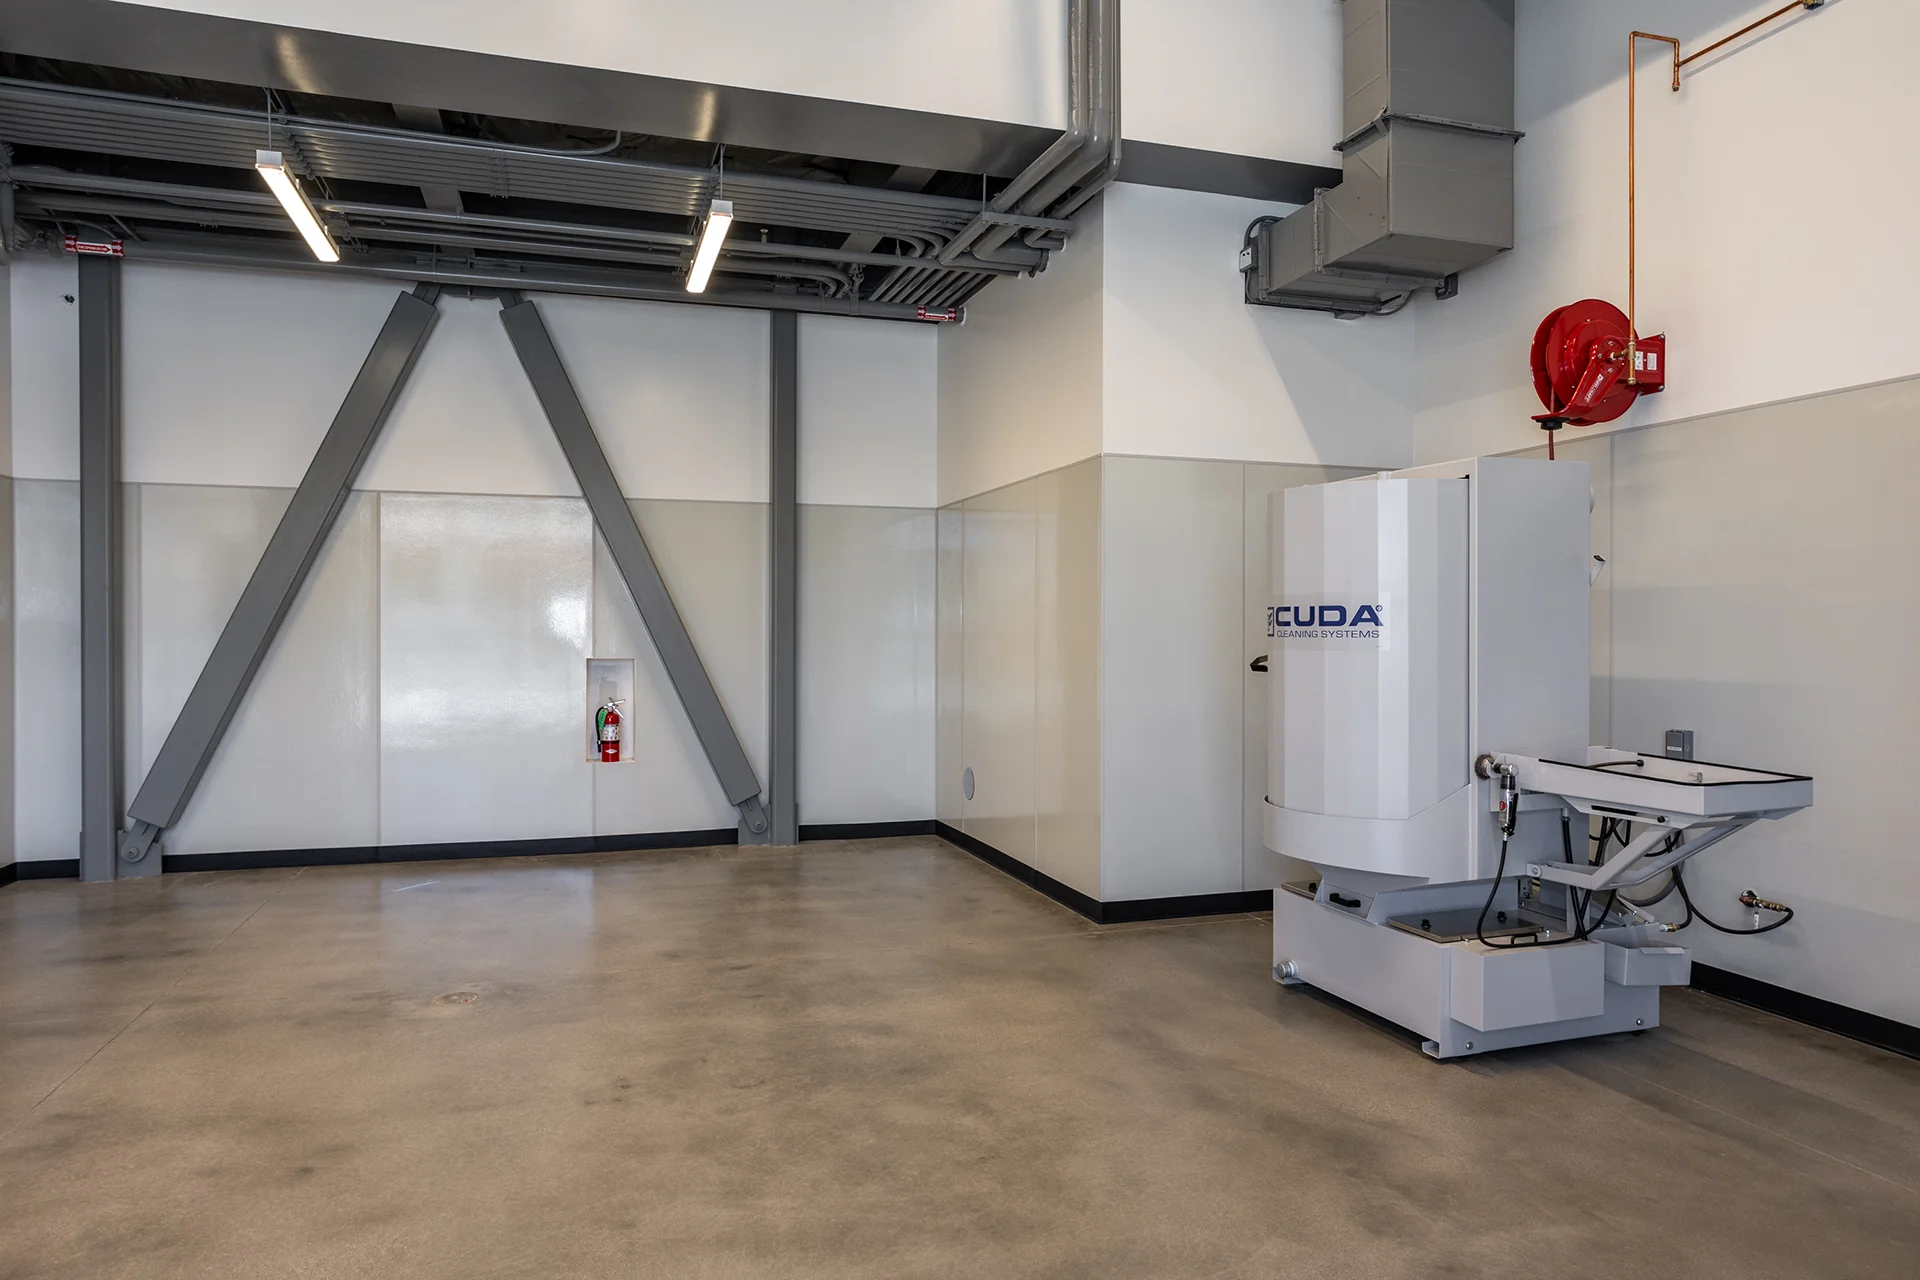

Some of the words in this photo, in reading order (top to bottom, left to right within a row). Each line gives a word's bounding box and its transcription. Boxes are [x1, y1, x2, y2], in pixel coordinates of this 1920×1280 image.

[1275, 605, 1384, 627] CUDA
[1276, 630, 1319, 638] CLEANING
[1320, 630, 1380, 638] SYSTEMS
